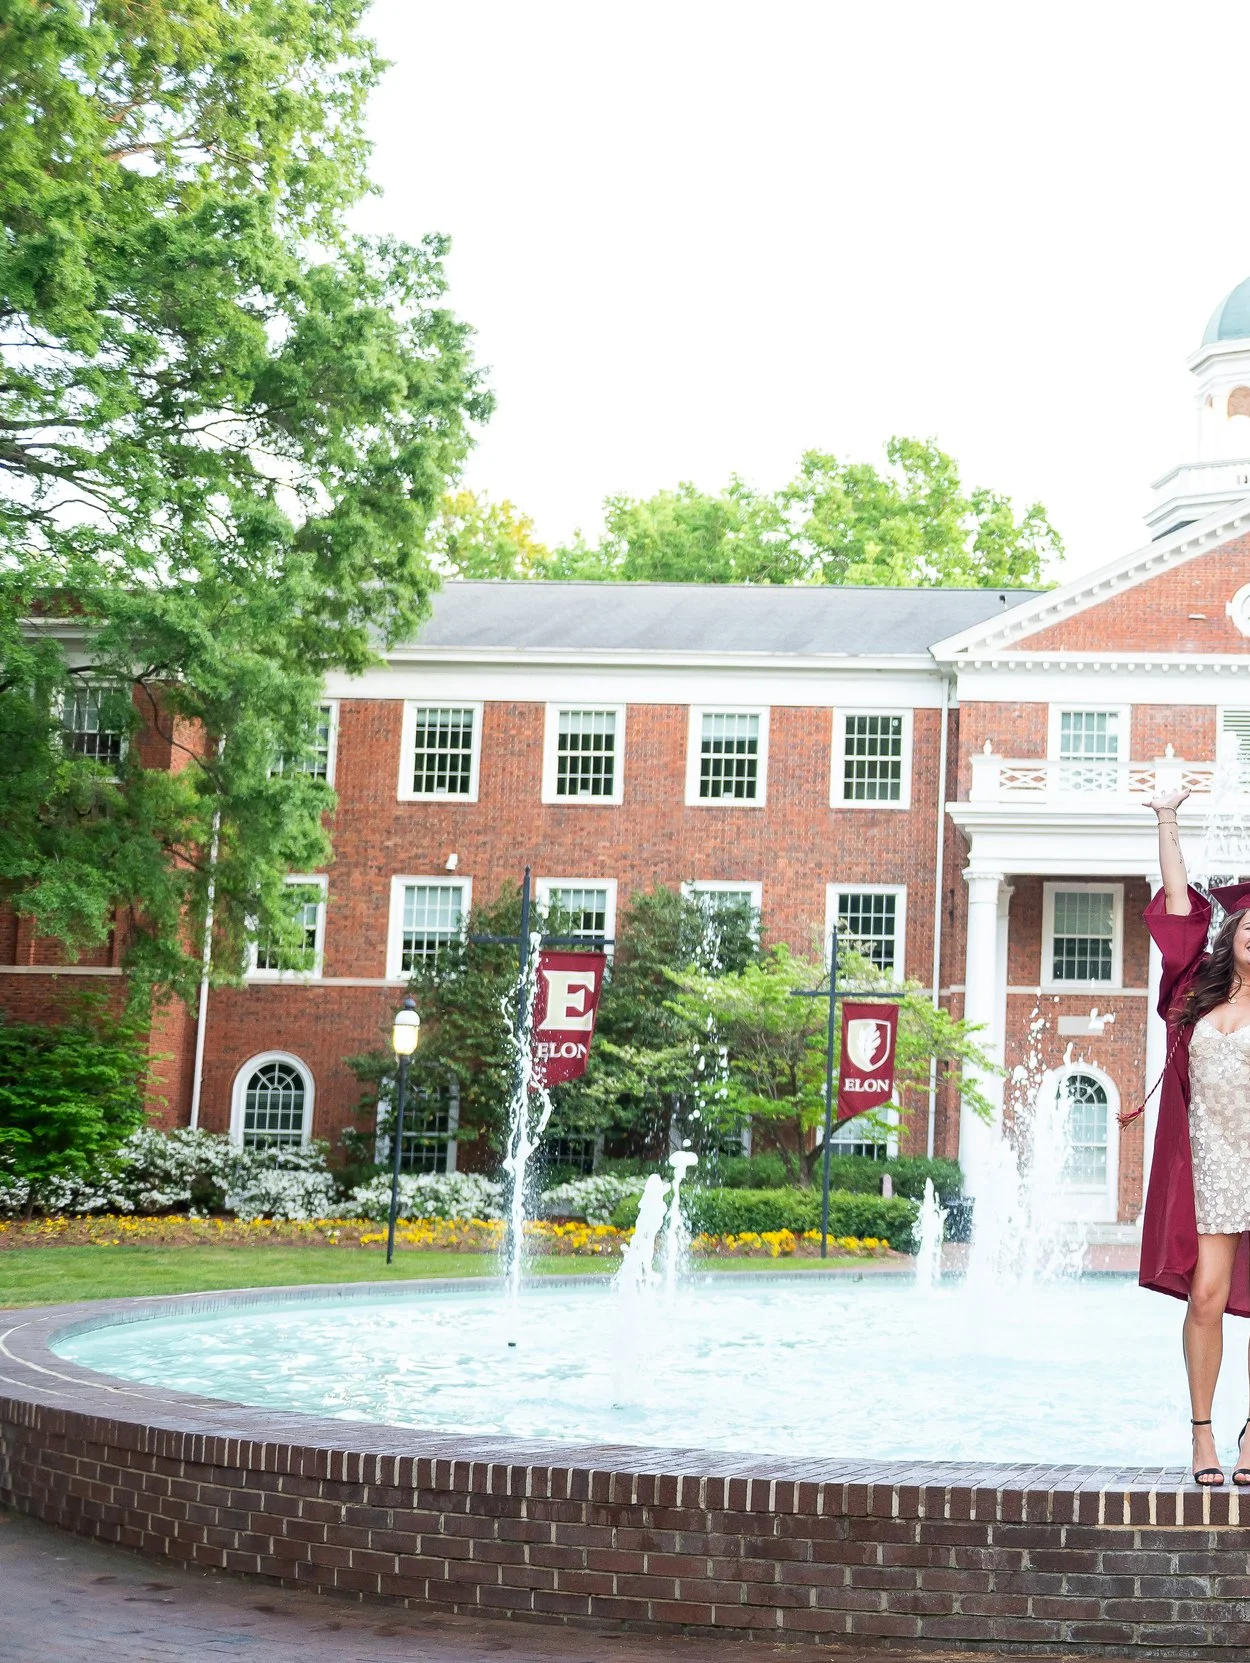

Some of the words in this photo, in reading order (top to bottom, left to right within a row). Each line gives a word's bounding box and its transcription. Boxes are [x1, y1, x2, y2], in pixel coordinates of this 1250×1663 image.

[538, 970, 596, 1031] E
[536, 1041, 587, 1058] ELON
[843, 1078, 890, 1093] ELON
